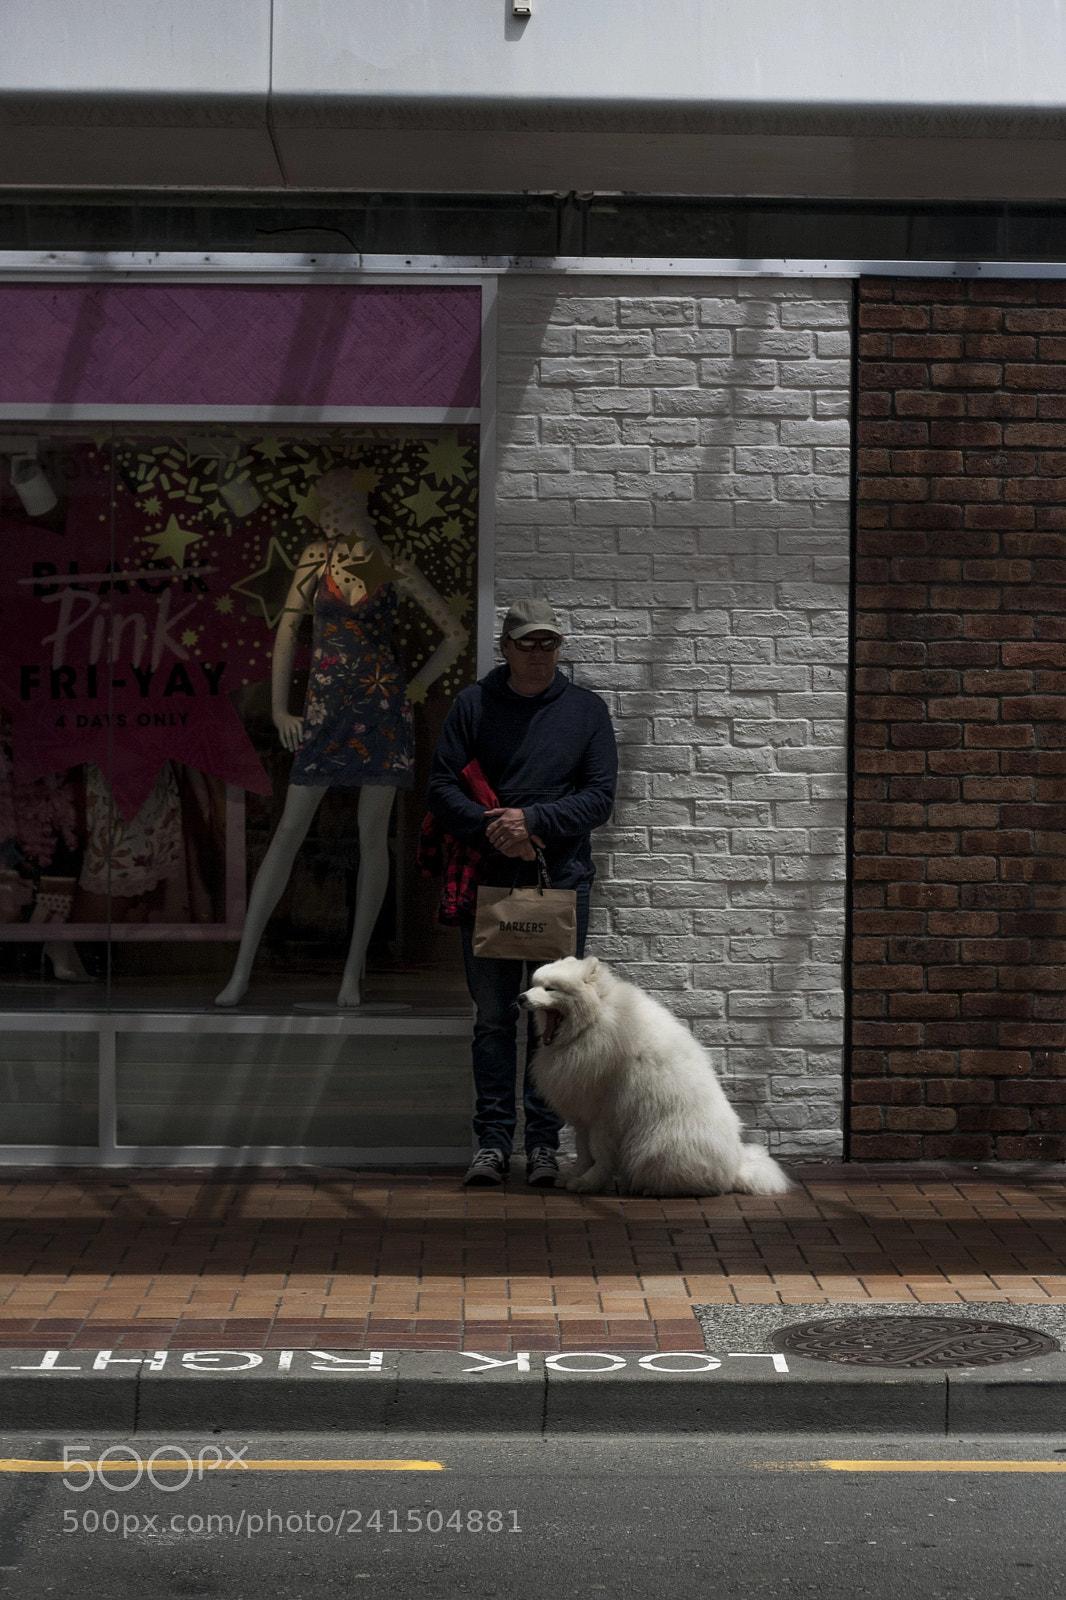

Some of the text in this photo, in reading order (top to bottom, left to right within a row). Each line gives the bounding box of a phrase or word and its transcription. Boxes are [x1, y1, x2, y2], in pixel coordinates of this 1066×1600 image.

[33, 559, 211, 597] BLACK
[41, 586, 198, 674] Pink
[20, 661, 227, 701] FRI-YAY
[55, 711, 189, 729] 4 DAYS ONLY
[499, 920, 544, 934] BARKERS
[10, 1350, 790, 1373] LOOK RIGHT
